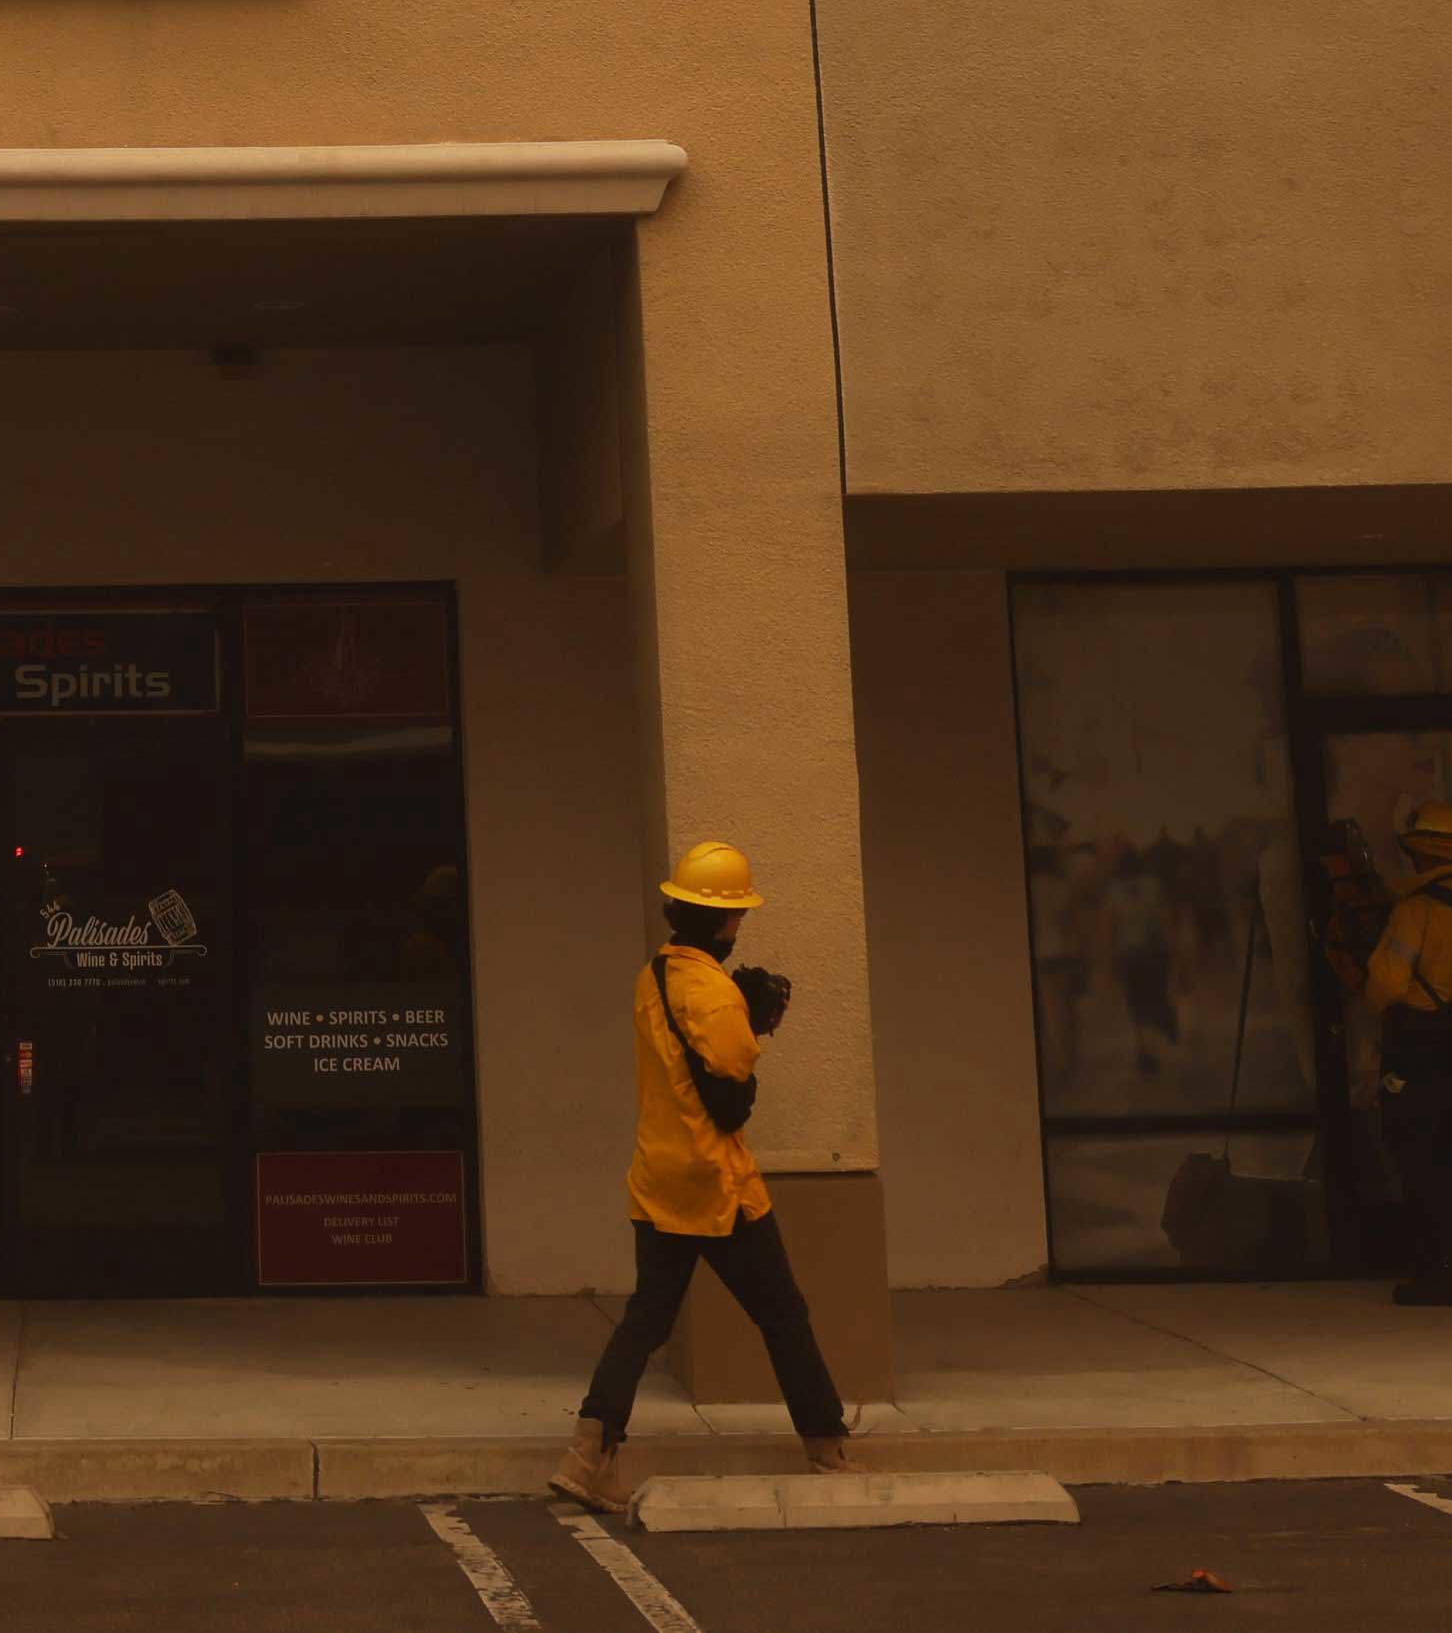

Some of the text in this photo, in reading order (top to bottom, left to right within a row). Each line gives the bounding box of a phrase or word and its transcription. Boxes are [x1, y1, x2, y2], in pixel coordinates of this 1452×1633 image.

[15, 663, 171, 706] Spirits
[47, 911, 152, 948] Palisades
[76, 951, 163, 971] Wine & Spirits
[267, 1009, 445, 1026] WINE SPIRITS BEER
[264, 1033, 448, 1049] SOFT DRINKS SNACKS
[313, 1057, 400, 1072] ICE CREAM
[265, 1192, 457, 1206] PALISADESWINESANDSPIRITS.COM
[324, 1216, 399, 1228] DELIVERY LIST
[331, 1233, 392, 1245] WINE CLUB
